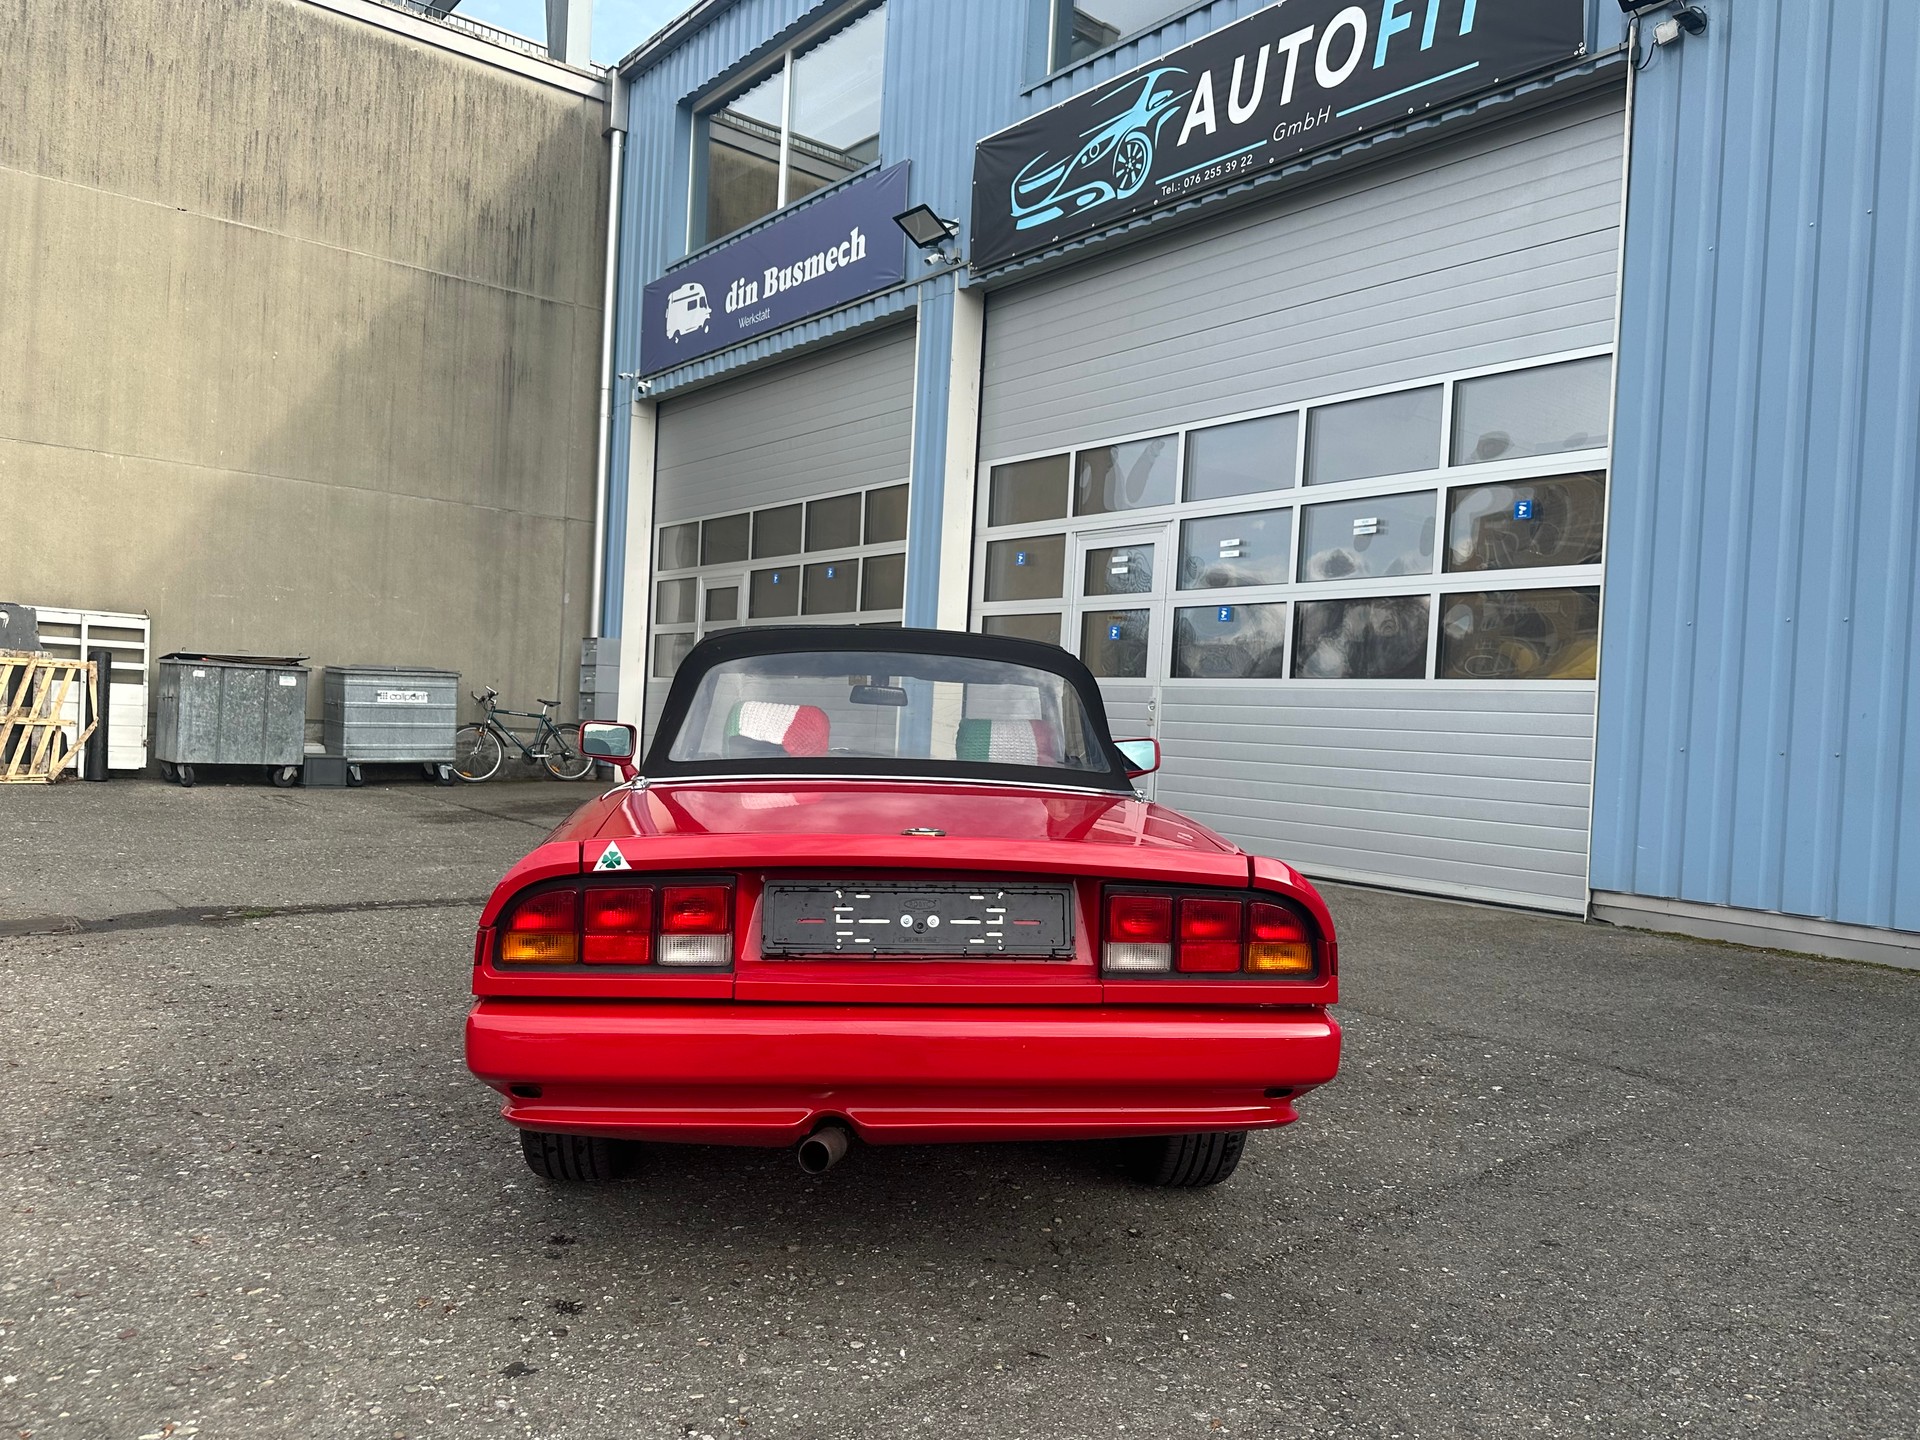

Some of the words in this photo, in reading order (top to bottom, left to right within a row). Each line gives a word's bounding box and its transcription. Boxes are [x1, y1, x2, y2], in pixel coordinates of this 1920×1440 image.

[1272, 105, 1331, 142] GmbH
[1161, 182, 1181, 196] Tel.:
[1183, 174, 1201, 189] 076
[1204, 165, 1222, 181] 255
[1225, 160, 1237, 173] 39
[1240, 154, 1253, 168] 22
[725, 277, 758, 314] din
[762, 226, 867, 299] Busmech
[738, 307, 771, 329] Werkstatt
